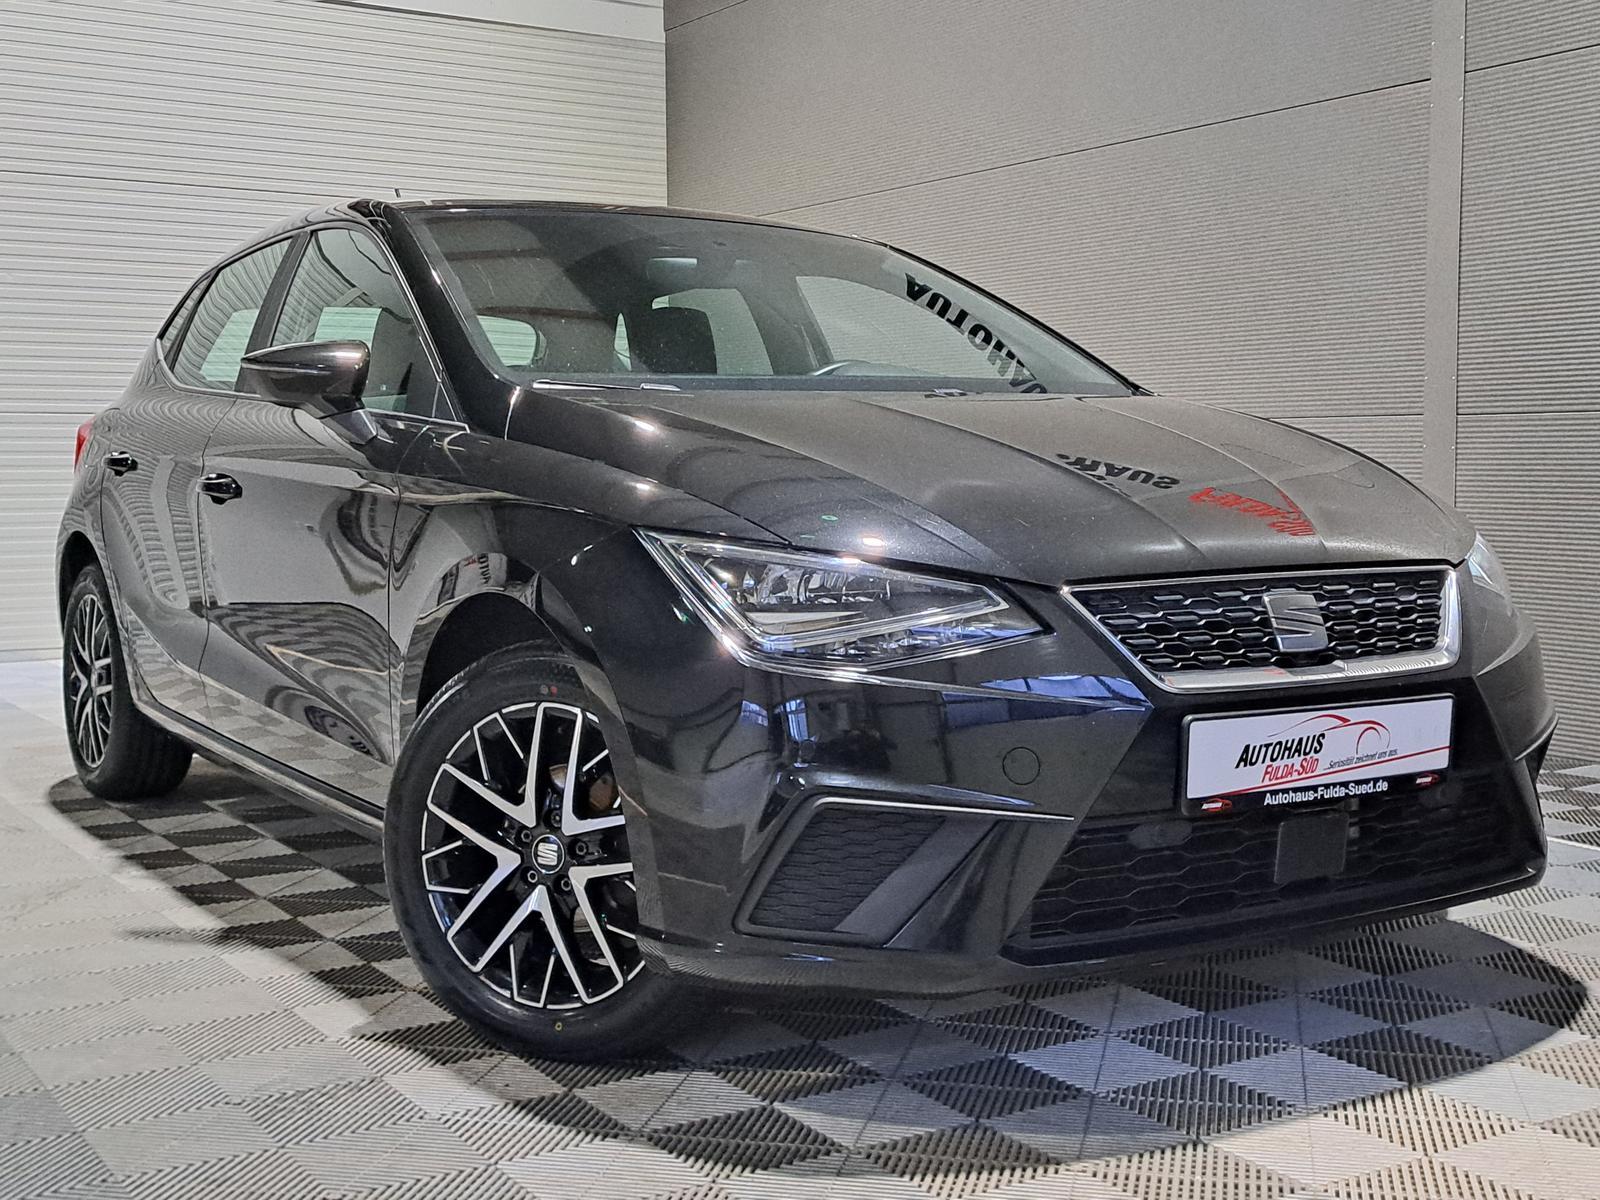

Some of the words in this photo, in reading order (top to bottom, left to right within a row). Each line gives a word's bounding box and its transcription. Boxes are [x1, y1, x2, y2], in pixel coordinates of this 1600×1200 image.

[1234, 732, 1326, 769] AUTOHAUS
[1261, 756, 1320, 783] FULDA-SÜD
[1264, 779, 1389, 806] Autohaus-Fulda-Sued.de
